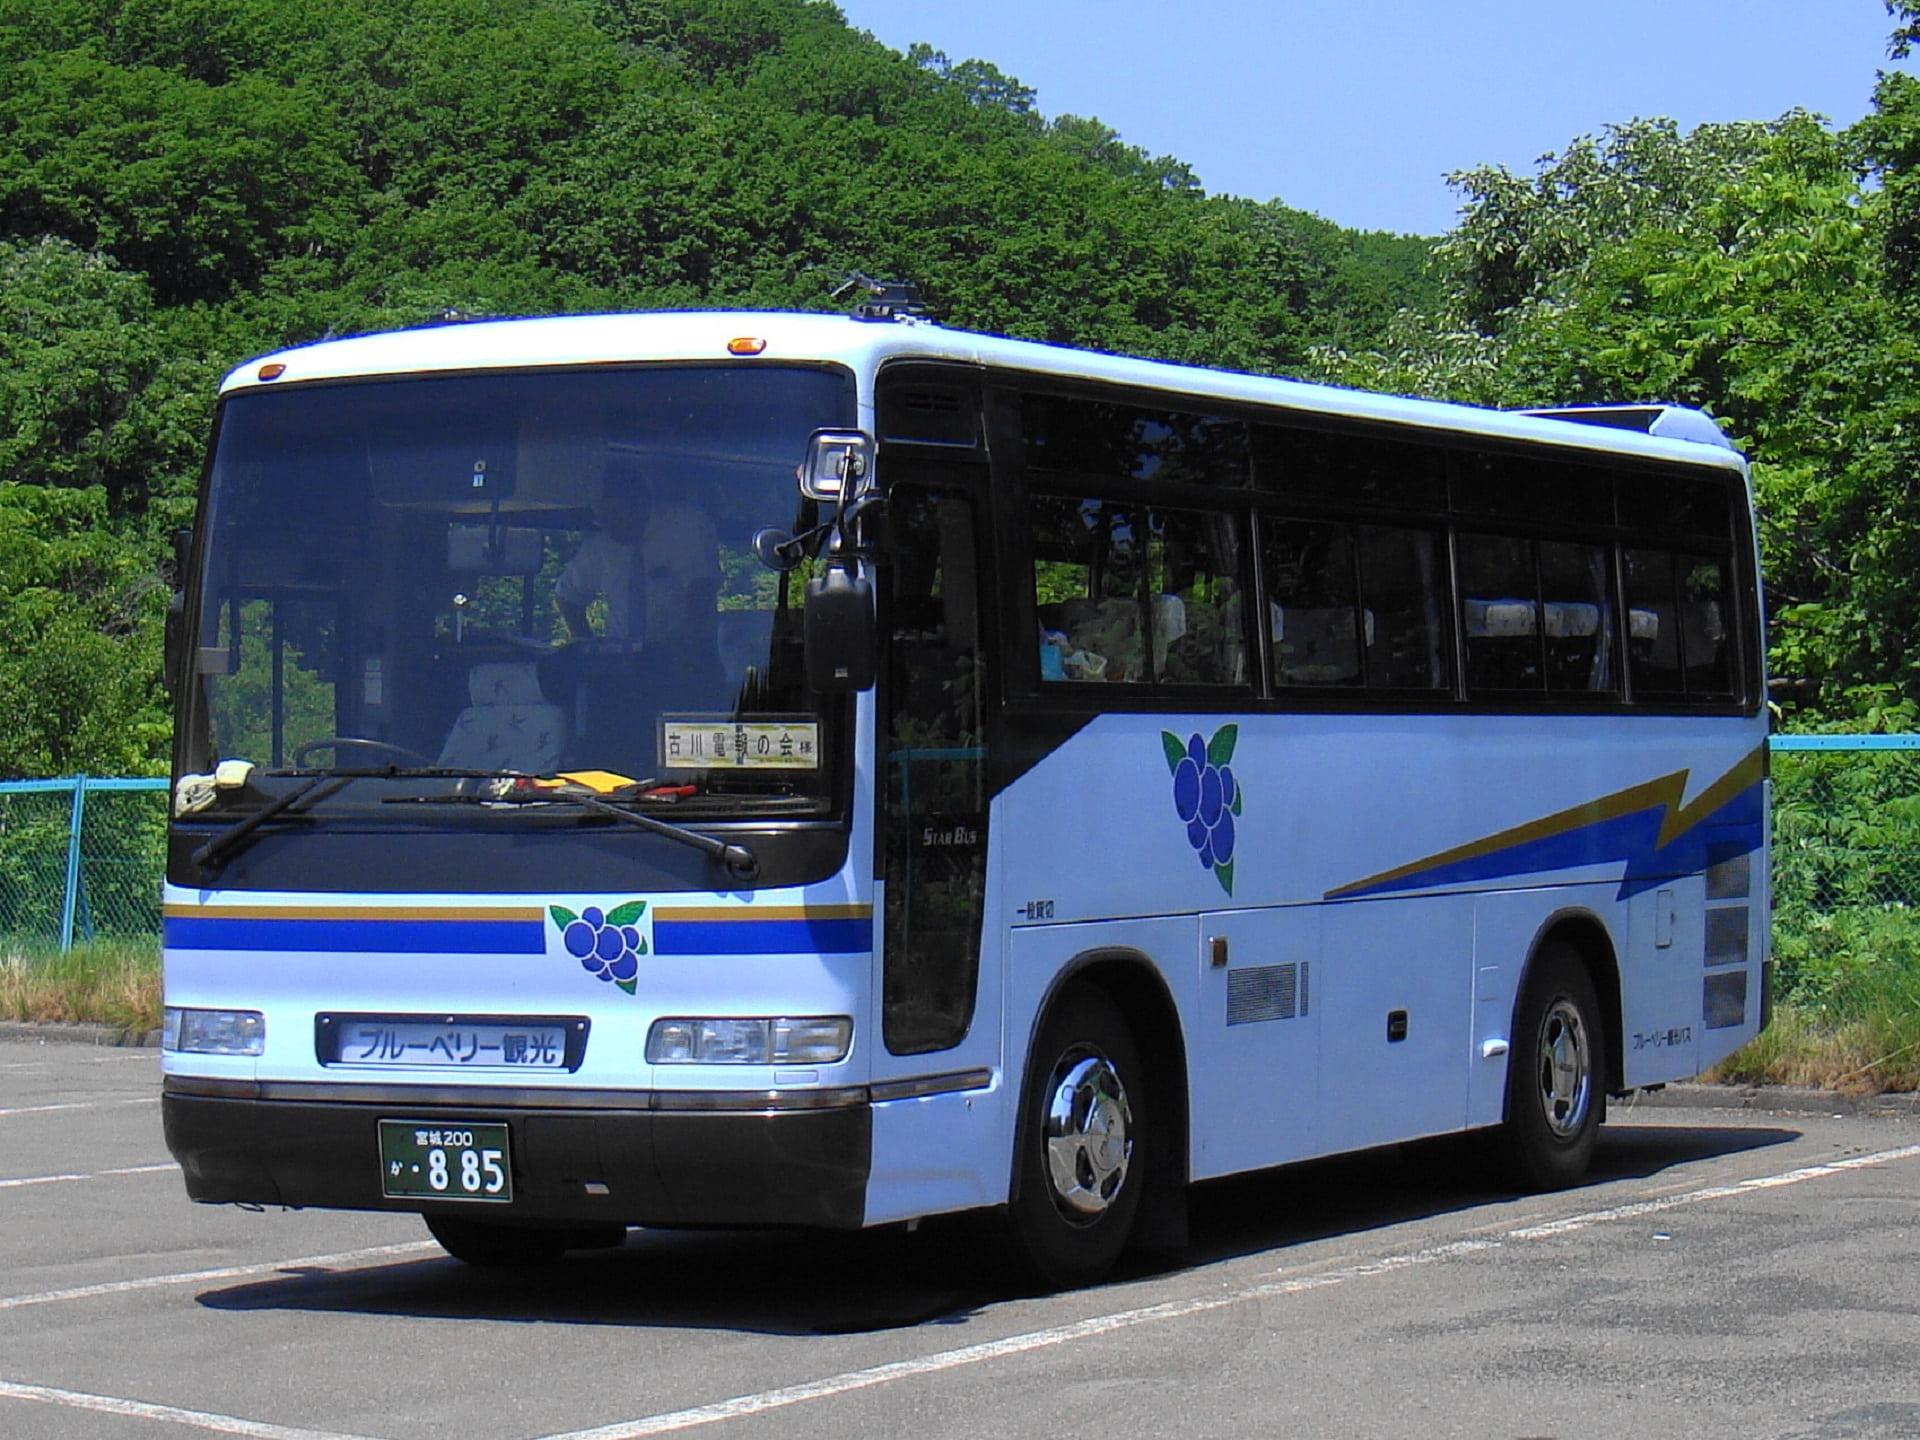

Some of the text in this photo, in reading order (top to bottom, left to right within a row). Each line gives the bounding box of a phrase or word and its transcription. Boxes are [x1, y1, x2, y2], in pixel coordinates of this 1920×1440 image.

[358, 1029, 556, 1064] ブルーベリー観光
